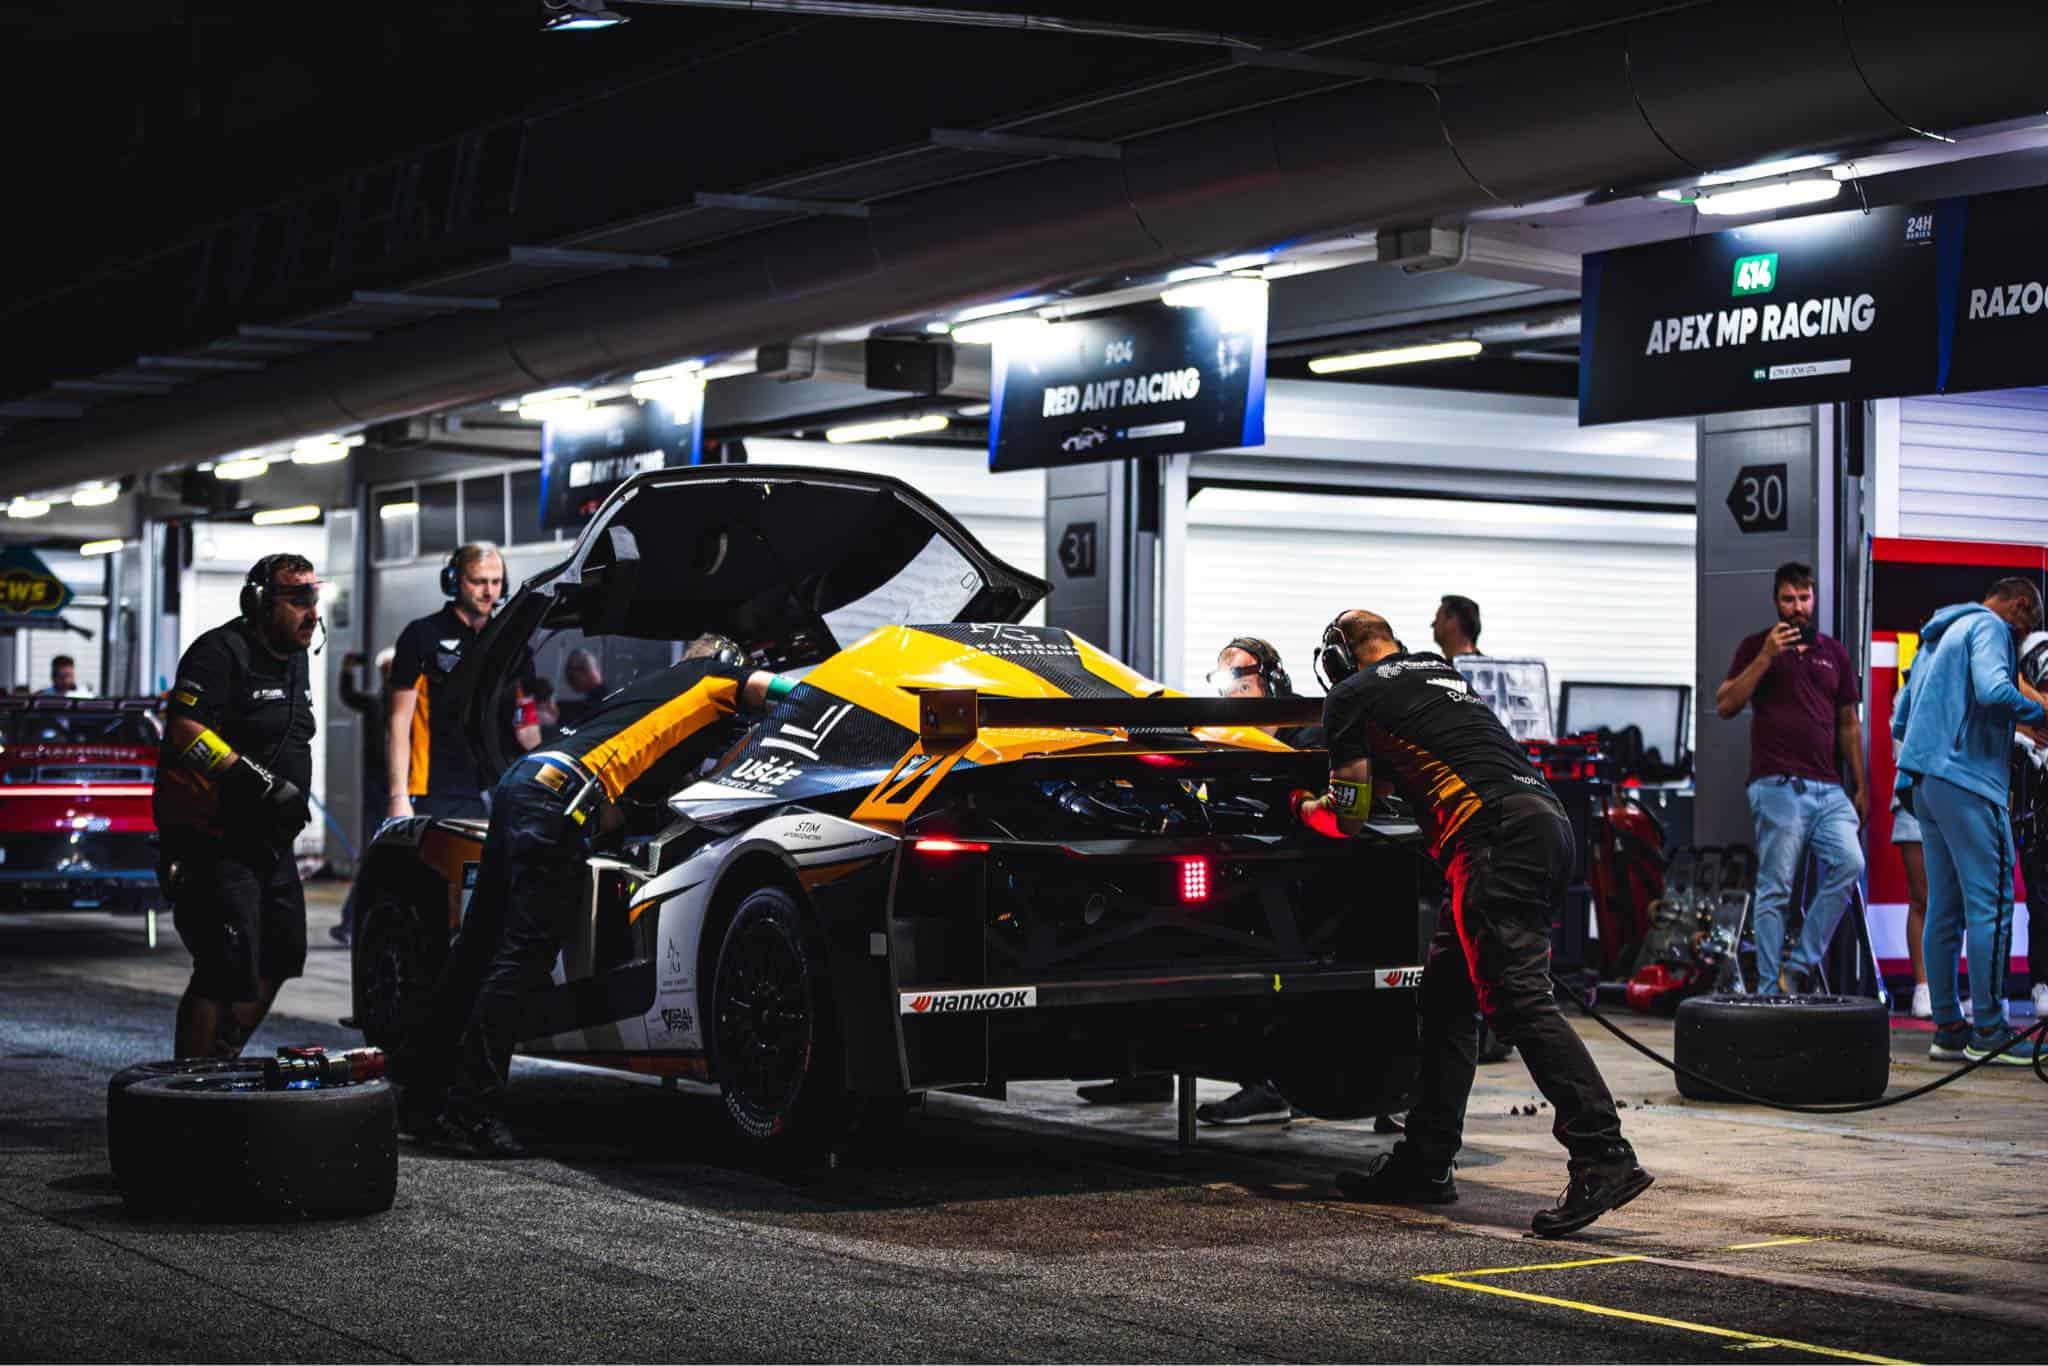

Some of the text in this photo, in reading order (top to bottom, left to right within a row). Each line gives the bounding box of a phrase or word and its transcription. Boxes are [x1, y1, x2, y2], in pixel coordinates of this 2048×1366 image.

[1907, 215, 1933, 232] 24H
[1737, 259, 1771, 290] 414
[1969, 281, 2048, 319] RAZO
[1646, 294, 1875, 355] APEX MP RACING
[1042, 367, 1200, 417] RED ANT RACING
[1742, 475, 1782, 520] 30
[1068, 532, 1091, 569] 31
[795, 821, 822, 833] STIM
